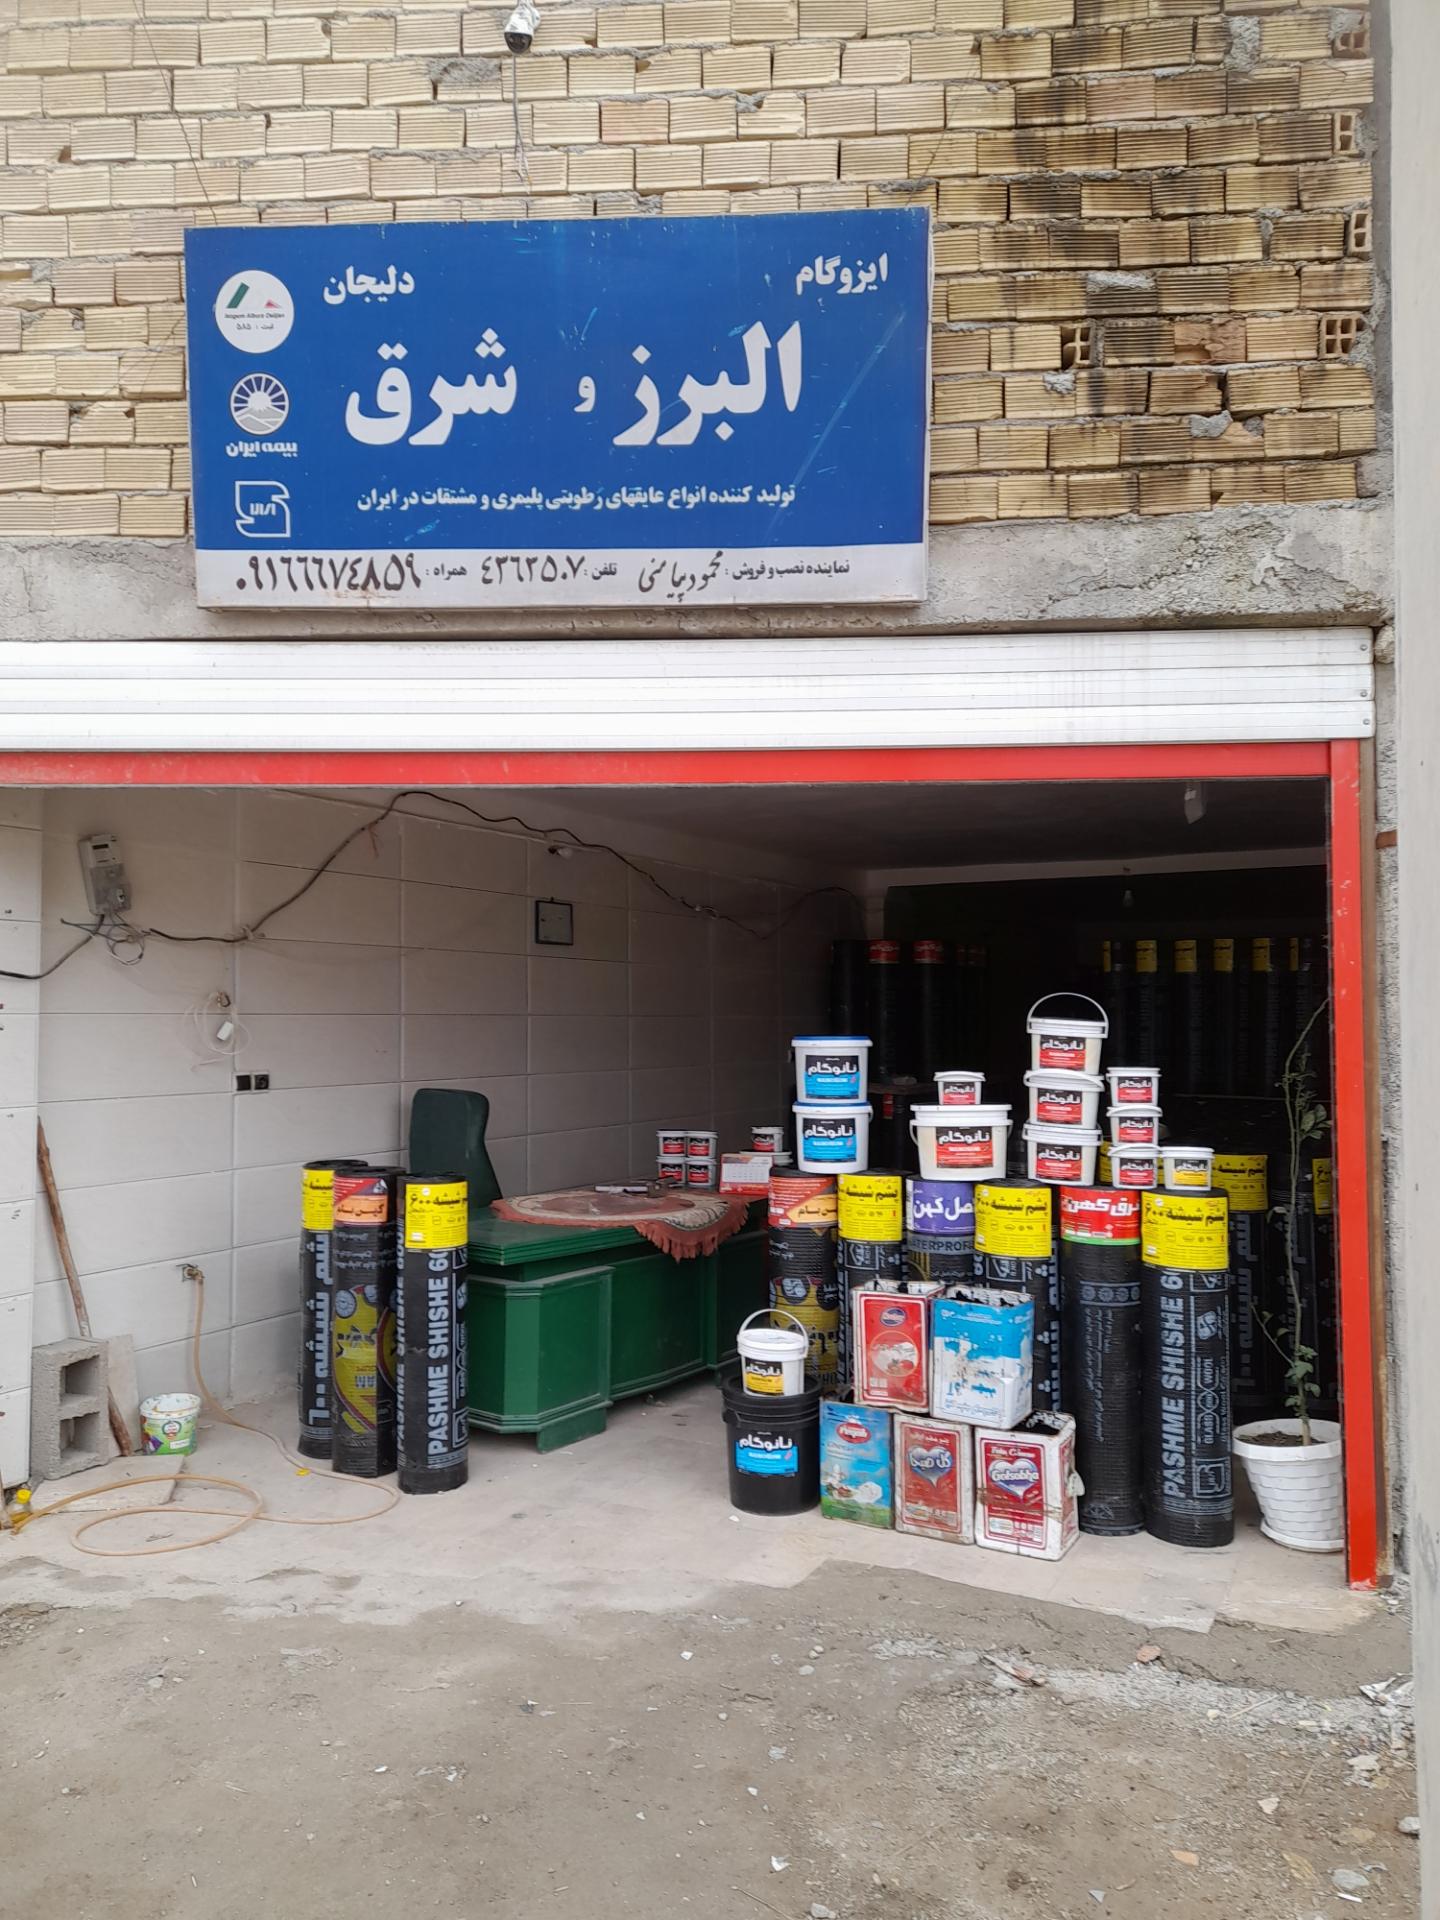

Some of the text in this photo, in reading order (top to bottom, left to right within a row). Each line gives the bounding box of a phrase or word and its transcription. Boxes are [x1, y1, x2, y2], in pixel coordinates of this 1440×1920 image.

[322, 252, 888, 305] ایزوگام دلیجان
[345, 320, 802, 446] البرز و شرق
[225, 440, 298, 457] بیمه ایران
[357, 484, 796, 511] تولید کننده انواع عایقهای رطوبتی پلیمری و مشتقات در ایران
[766, 567, 775, 579] و
[776, 560, 805, 578] نصب
[806, 559, 850, 579] نماینده
[428, 1276, 449, 1358] SHISHE
[1160, 1296, 1186, 1390] SHISHE
[428, 1363, 449, 1454] PASHME
[1161, 1396, 1187, 1499] PASHME
